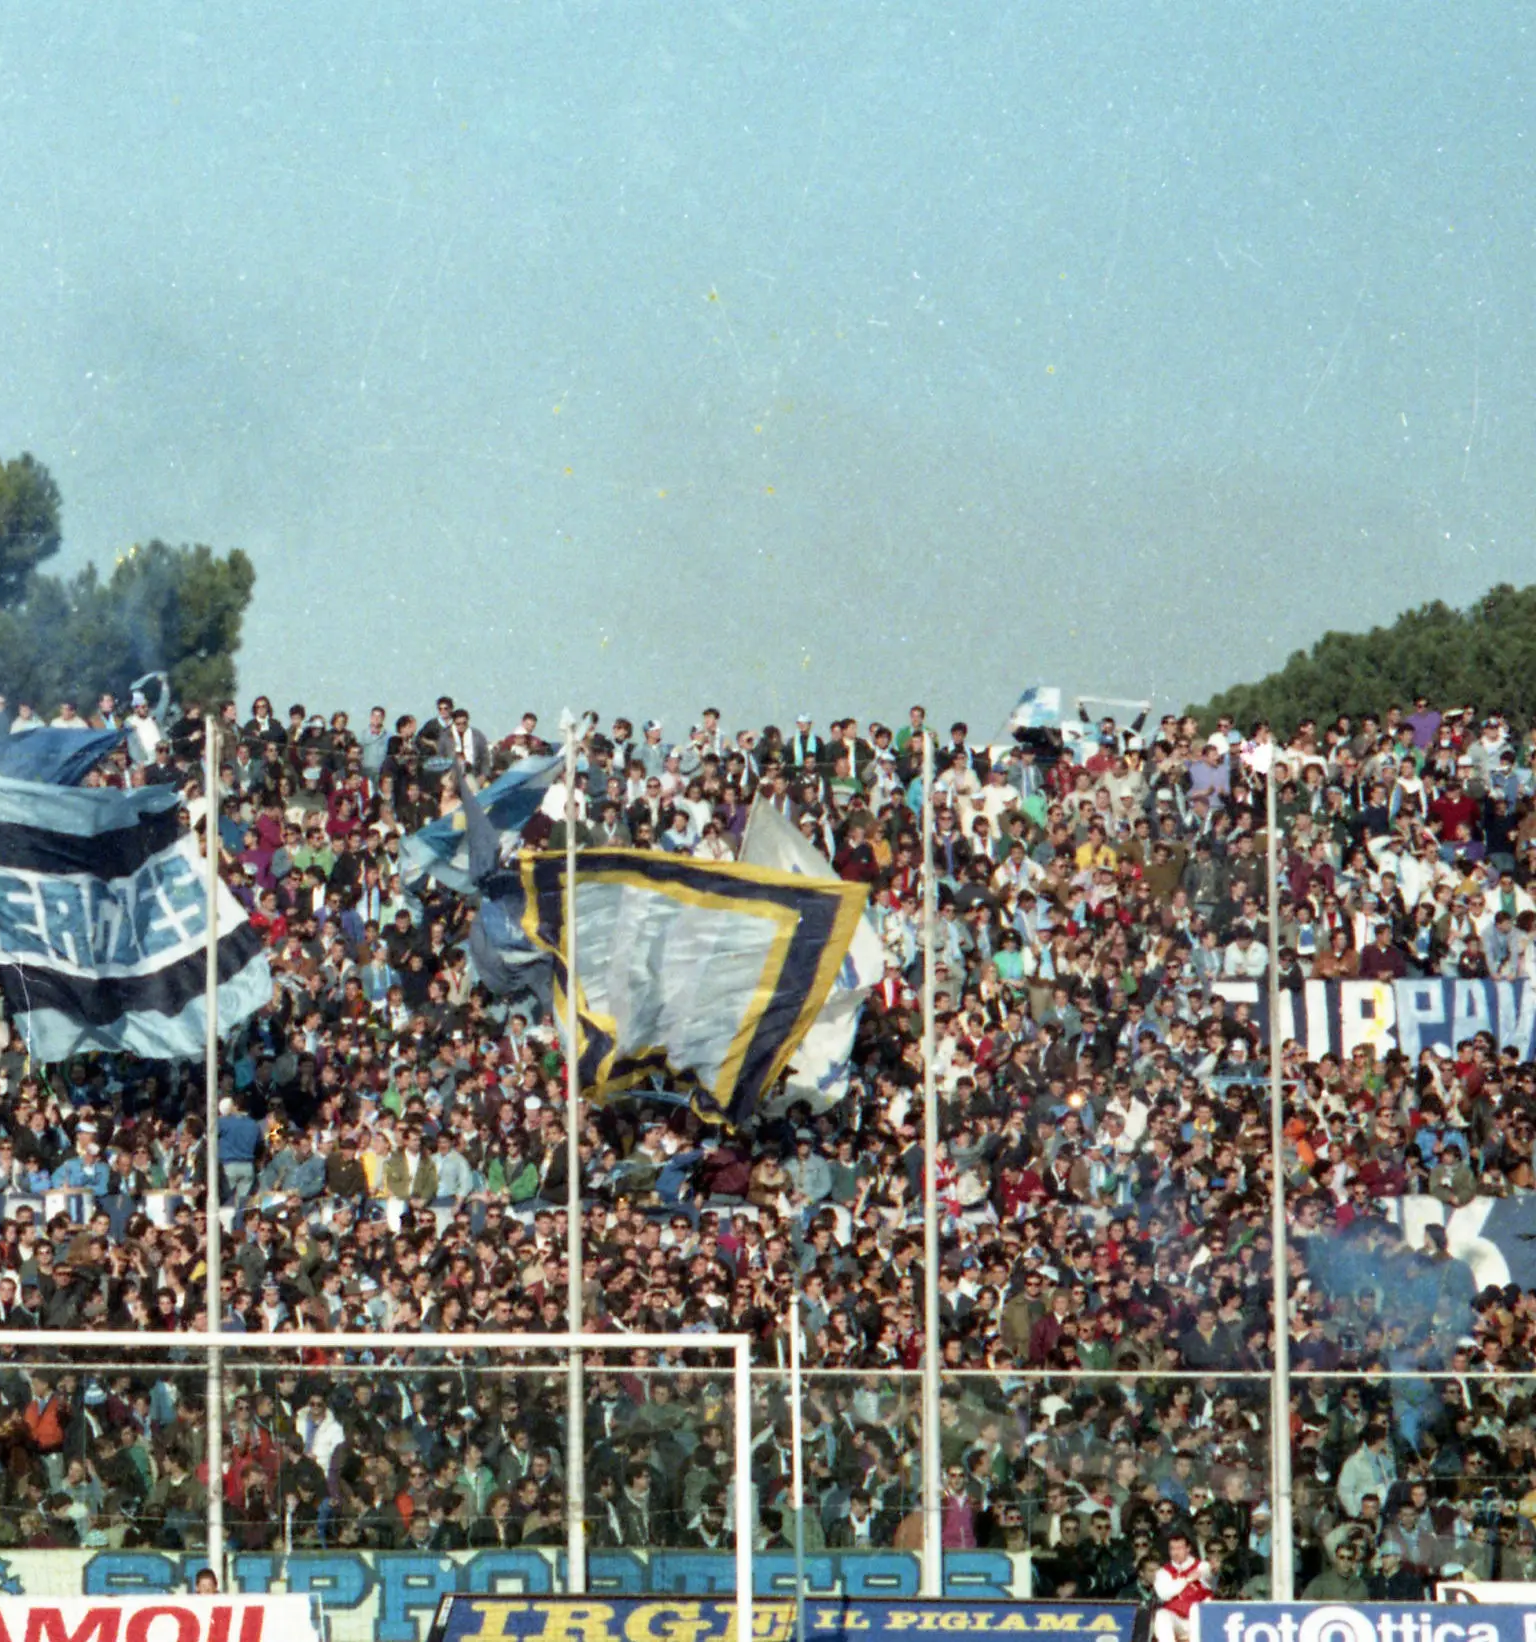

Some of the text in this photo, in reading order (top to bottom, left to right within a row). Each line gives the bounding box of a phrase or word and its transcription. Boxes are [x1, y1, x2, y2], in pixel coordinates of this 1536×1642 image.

[460, 1600, 798, 1642] IRGE
[813, 1609, 1123, 1631] IL PIGIAMA
